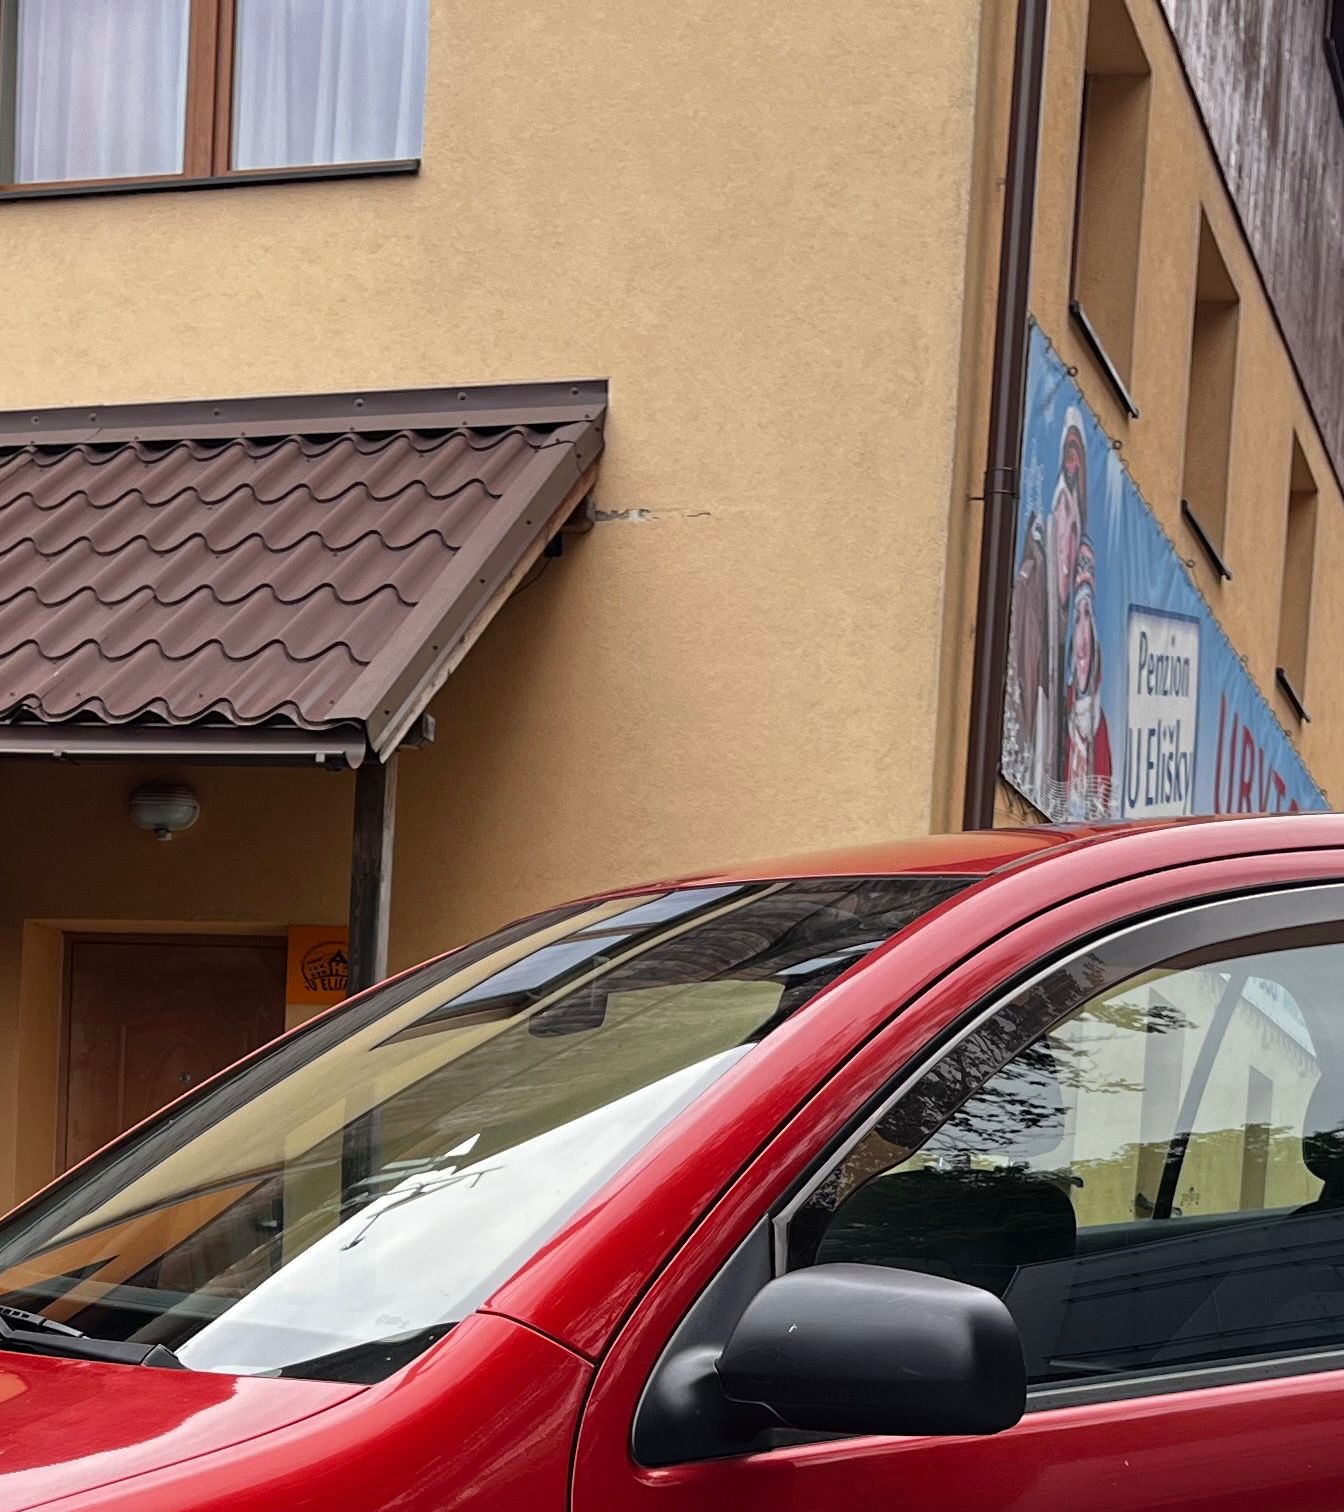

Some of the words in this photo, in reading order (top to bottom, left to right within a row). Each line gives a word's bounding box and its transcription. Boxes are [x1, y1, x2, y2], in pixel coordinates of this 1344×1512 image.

[1137, 631, 1190, 697] Penzion
[1127, 728, 1142, 809] U
[1145, 718, 1194, 816] Elišky
